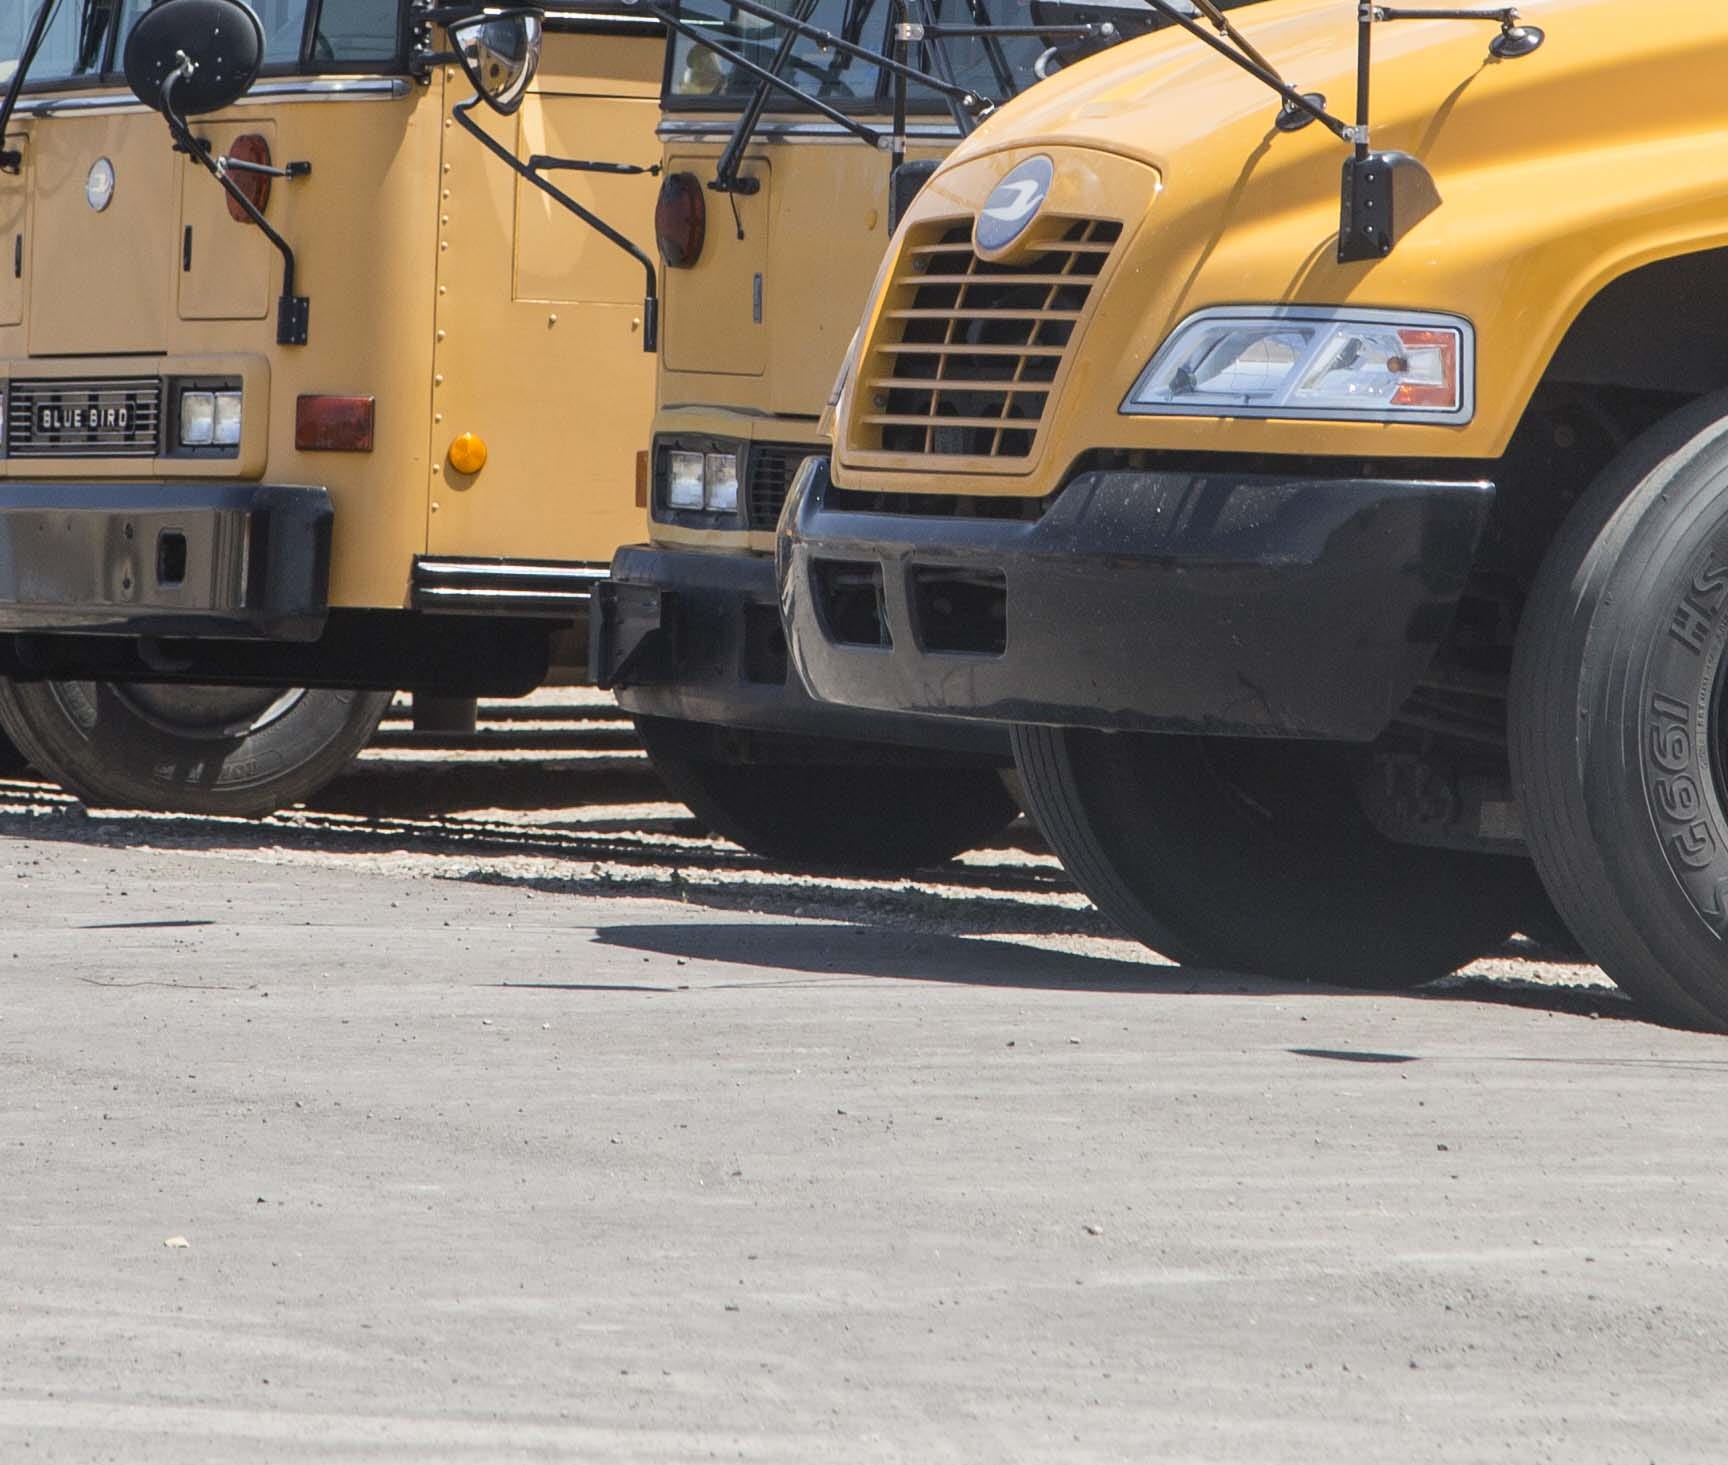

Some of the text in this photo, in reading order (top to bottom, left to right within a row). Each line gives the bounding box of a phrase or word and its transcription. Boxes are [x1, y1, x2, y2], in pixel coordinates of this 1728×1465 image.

[43, 408, 127, 428] BLUE BIRD
[1650, 691, 1717, 869] G661
